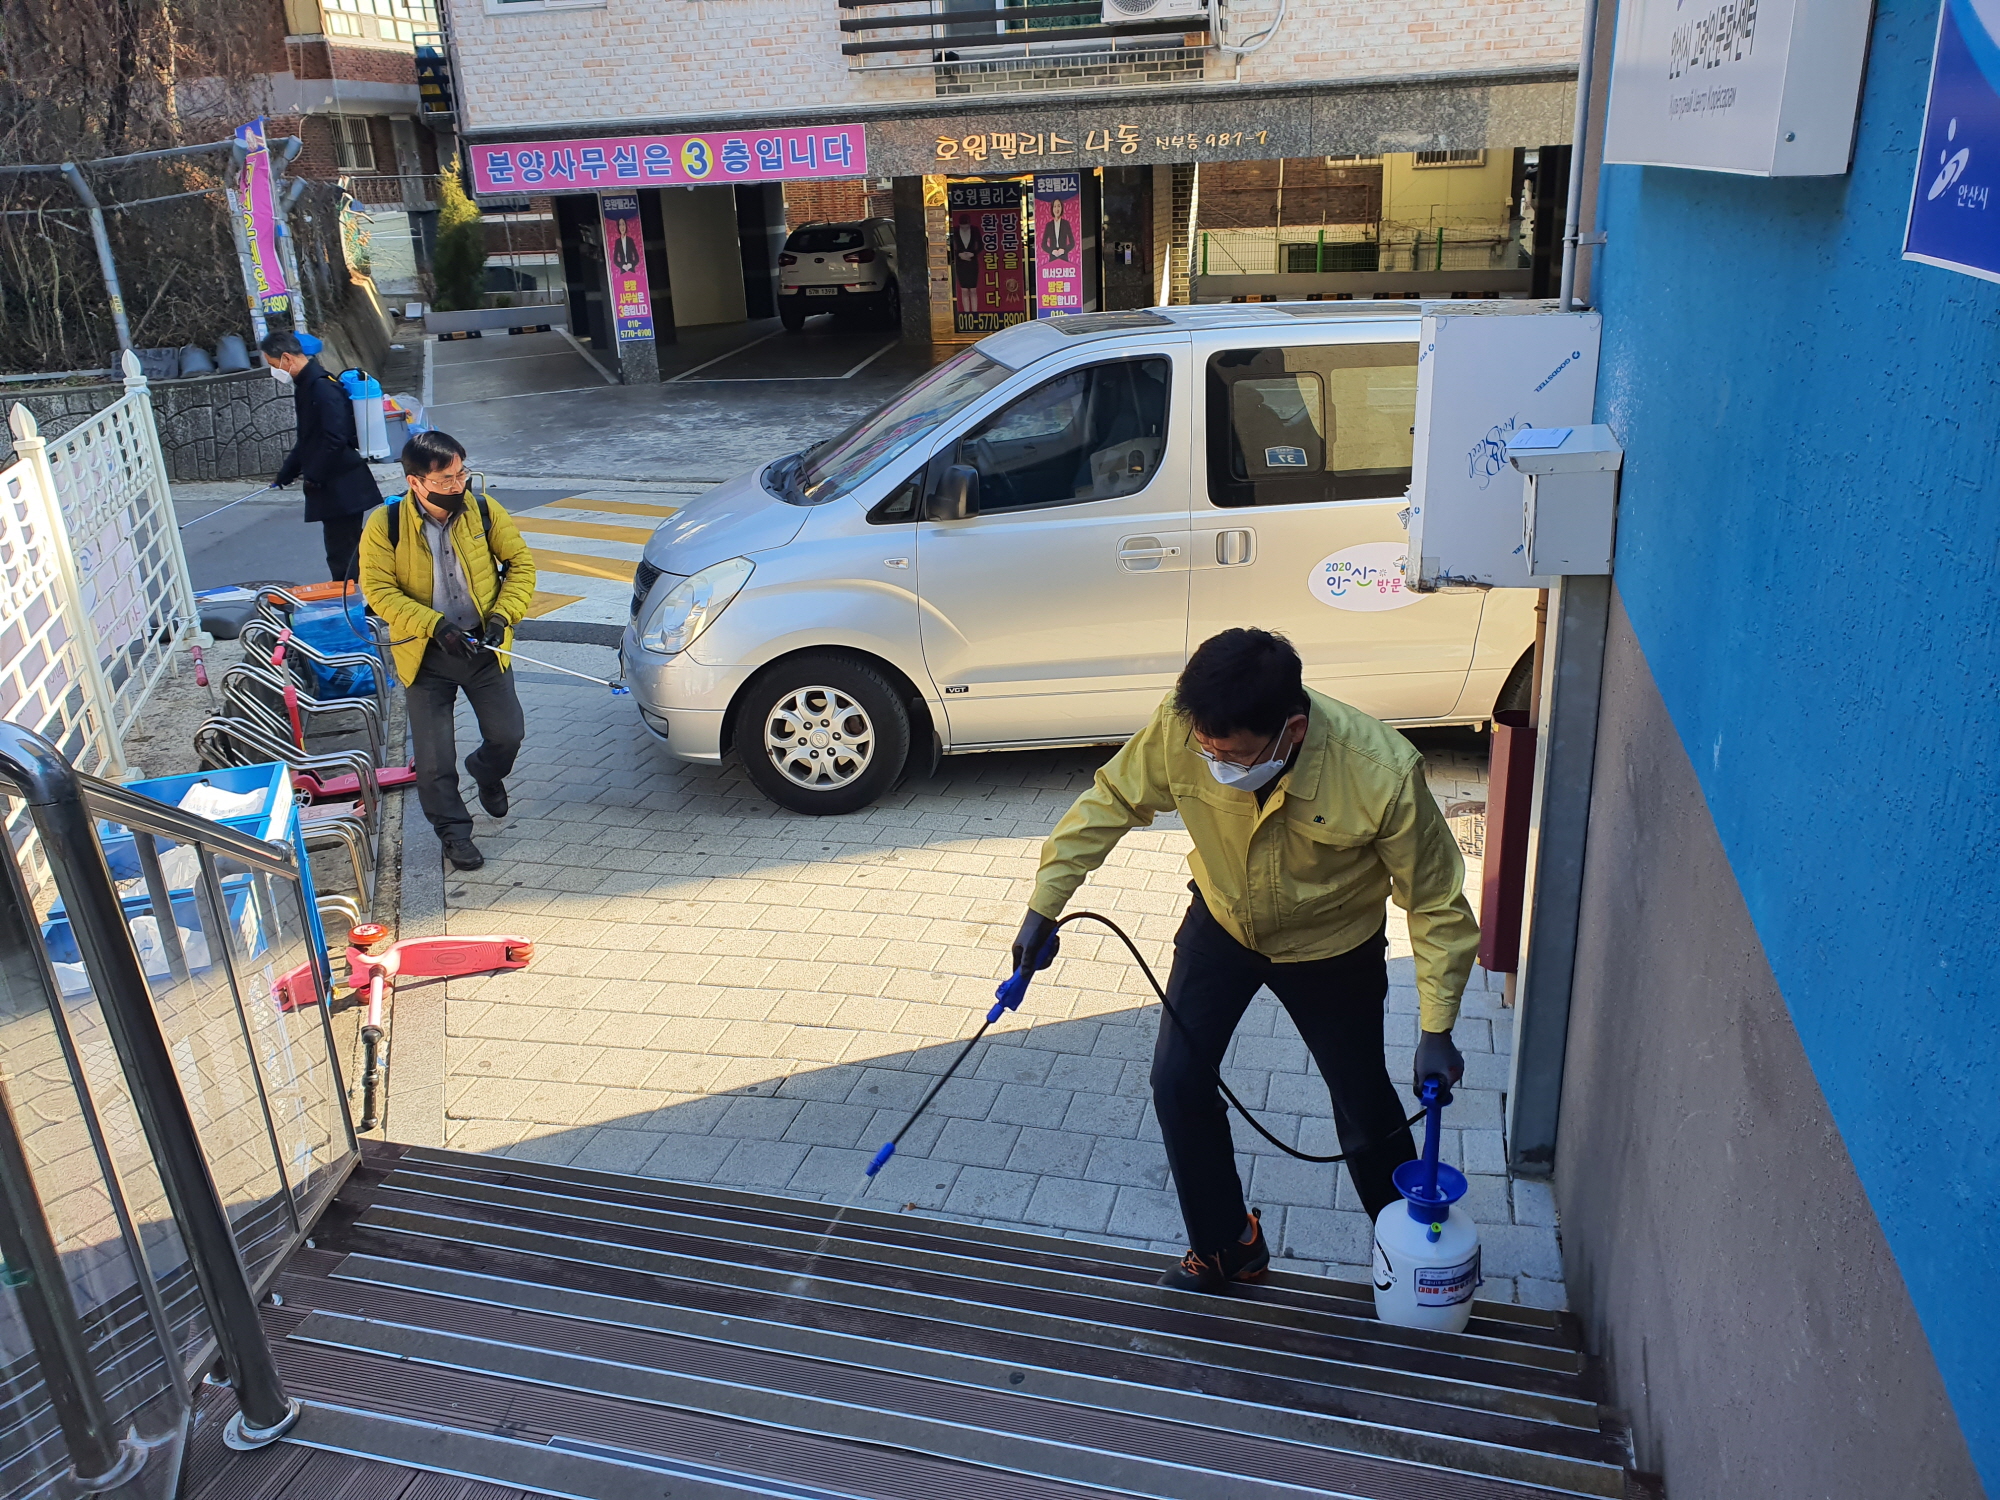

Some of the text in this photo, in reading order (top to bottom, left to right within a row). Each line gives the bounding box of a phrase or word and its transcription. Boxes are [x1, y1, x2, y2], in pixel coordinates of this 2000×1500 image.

[934, 130, 1075, 162] 호원팰리스
[1084, 123, 1142, 155] 나동
[486, 144, 673, 184] 분양사무실은
[953, 187, 1018, 206] 호원팰리스
[1957, 184, 1990, 212] 안산시
[1042, 267, 1077, 279] 어서오세요
[619, 292, 645, 304] 사무실은
[1041, 294, 1078, 307] 환영합니다
[618, 303, 648, 318] 3층입니다
[1533, 357, 1571, 393] GOODSTEEL
[1325, 561, 1352, 573] 2020
[1326, 566, 1378, 597] 안산
